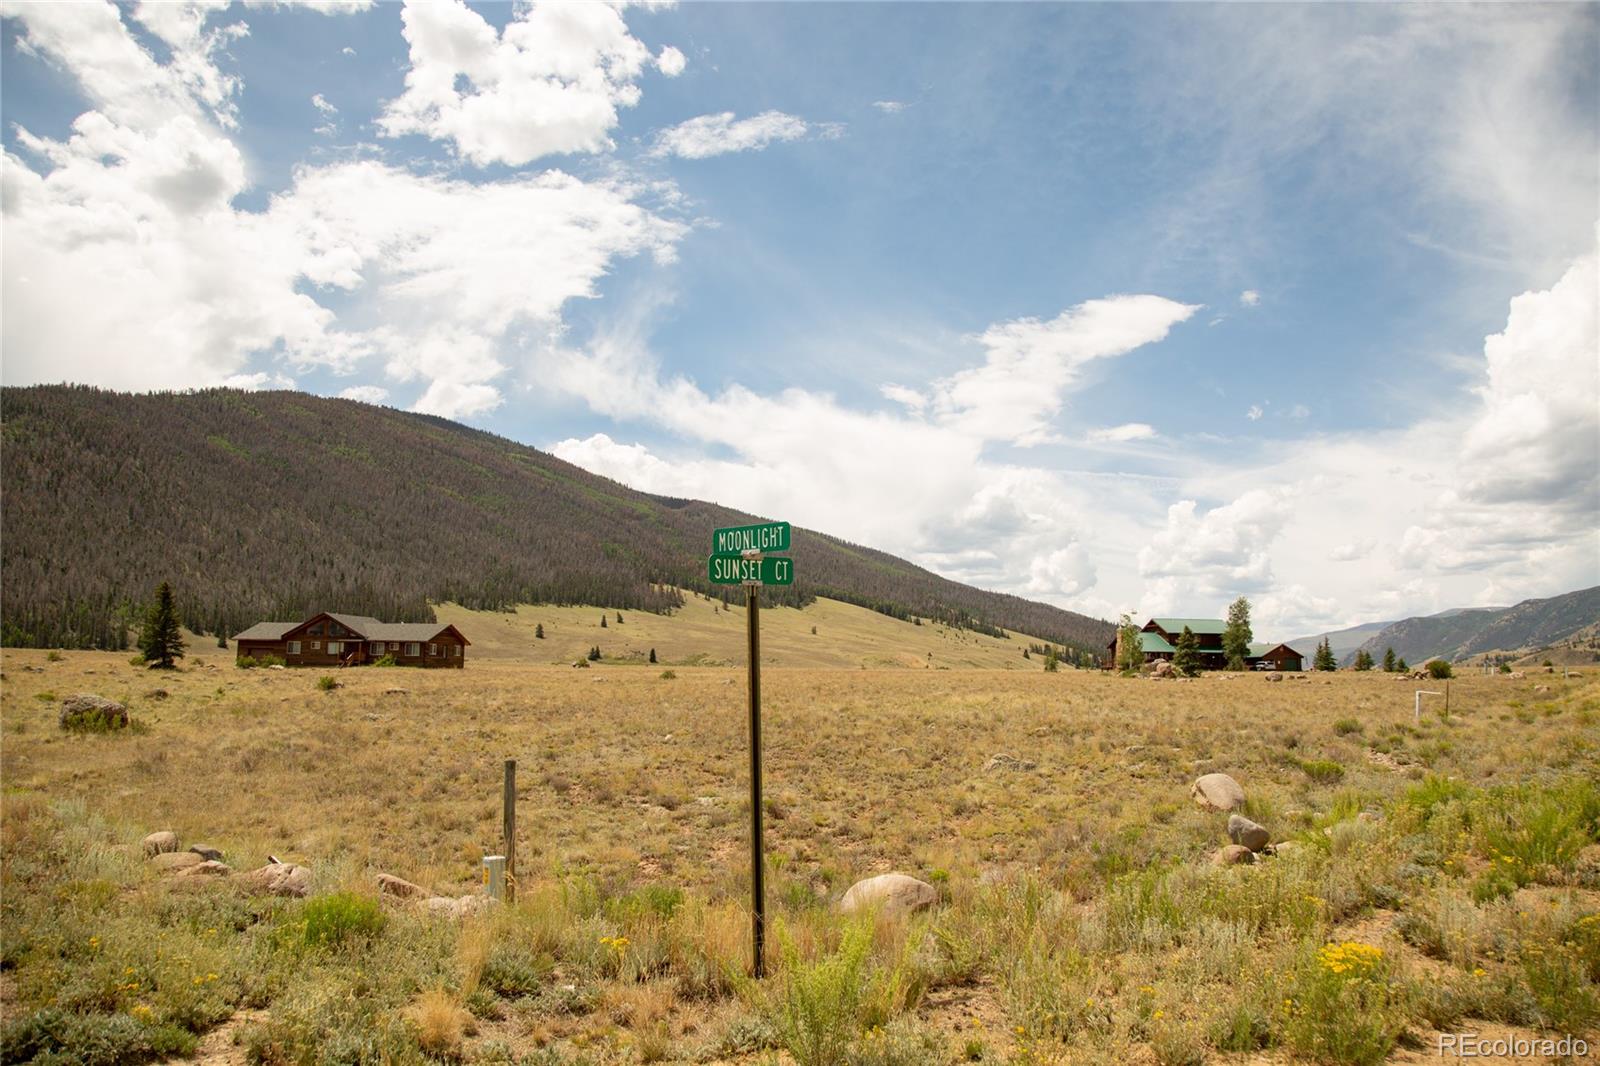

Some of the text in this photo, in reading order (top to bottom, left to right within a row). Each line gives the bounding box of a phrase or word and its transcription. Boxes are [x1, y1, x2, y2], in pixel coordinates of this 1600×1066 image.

[718, 526, 784, 552] MOONLIGHT
[714, 558, 788, 581] SUNSET CT
